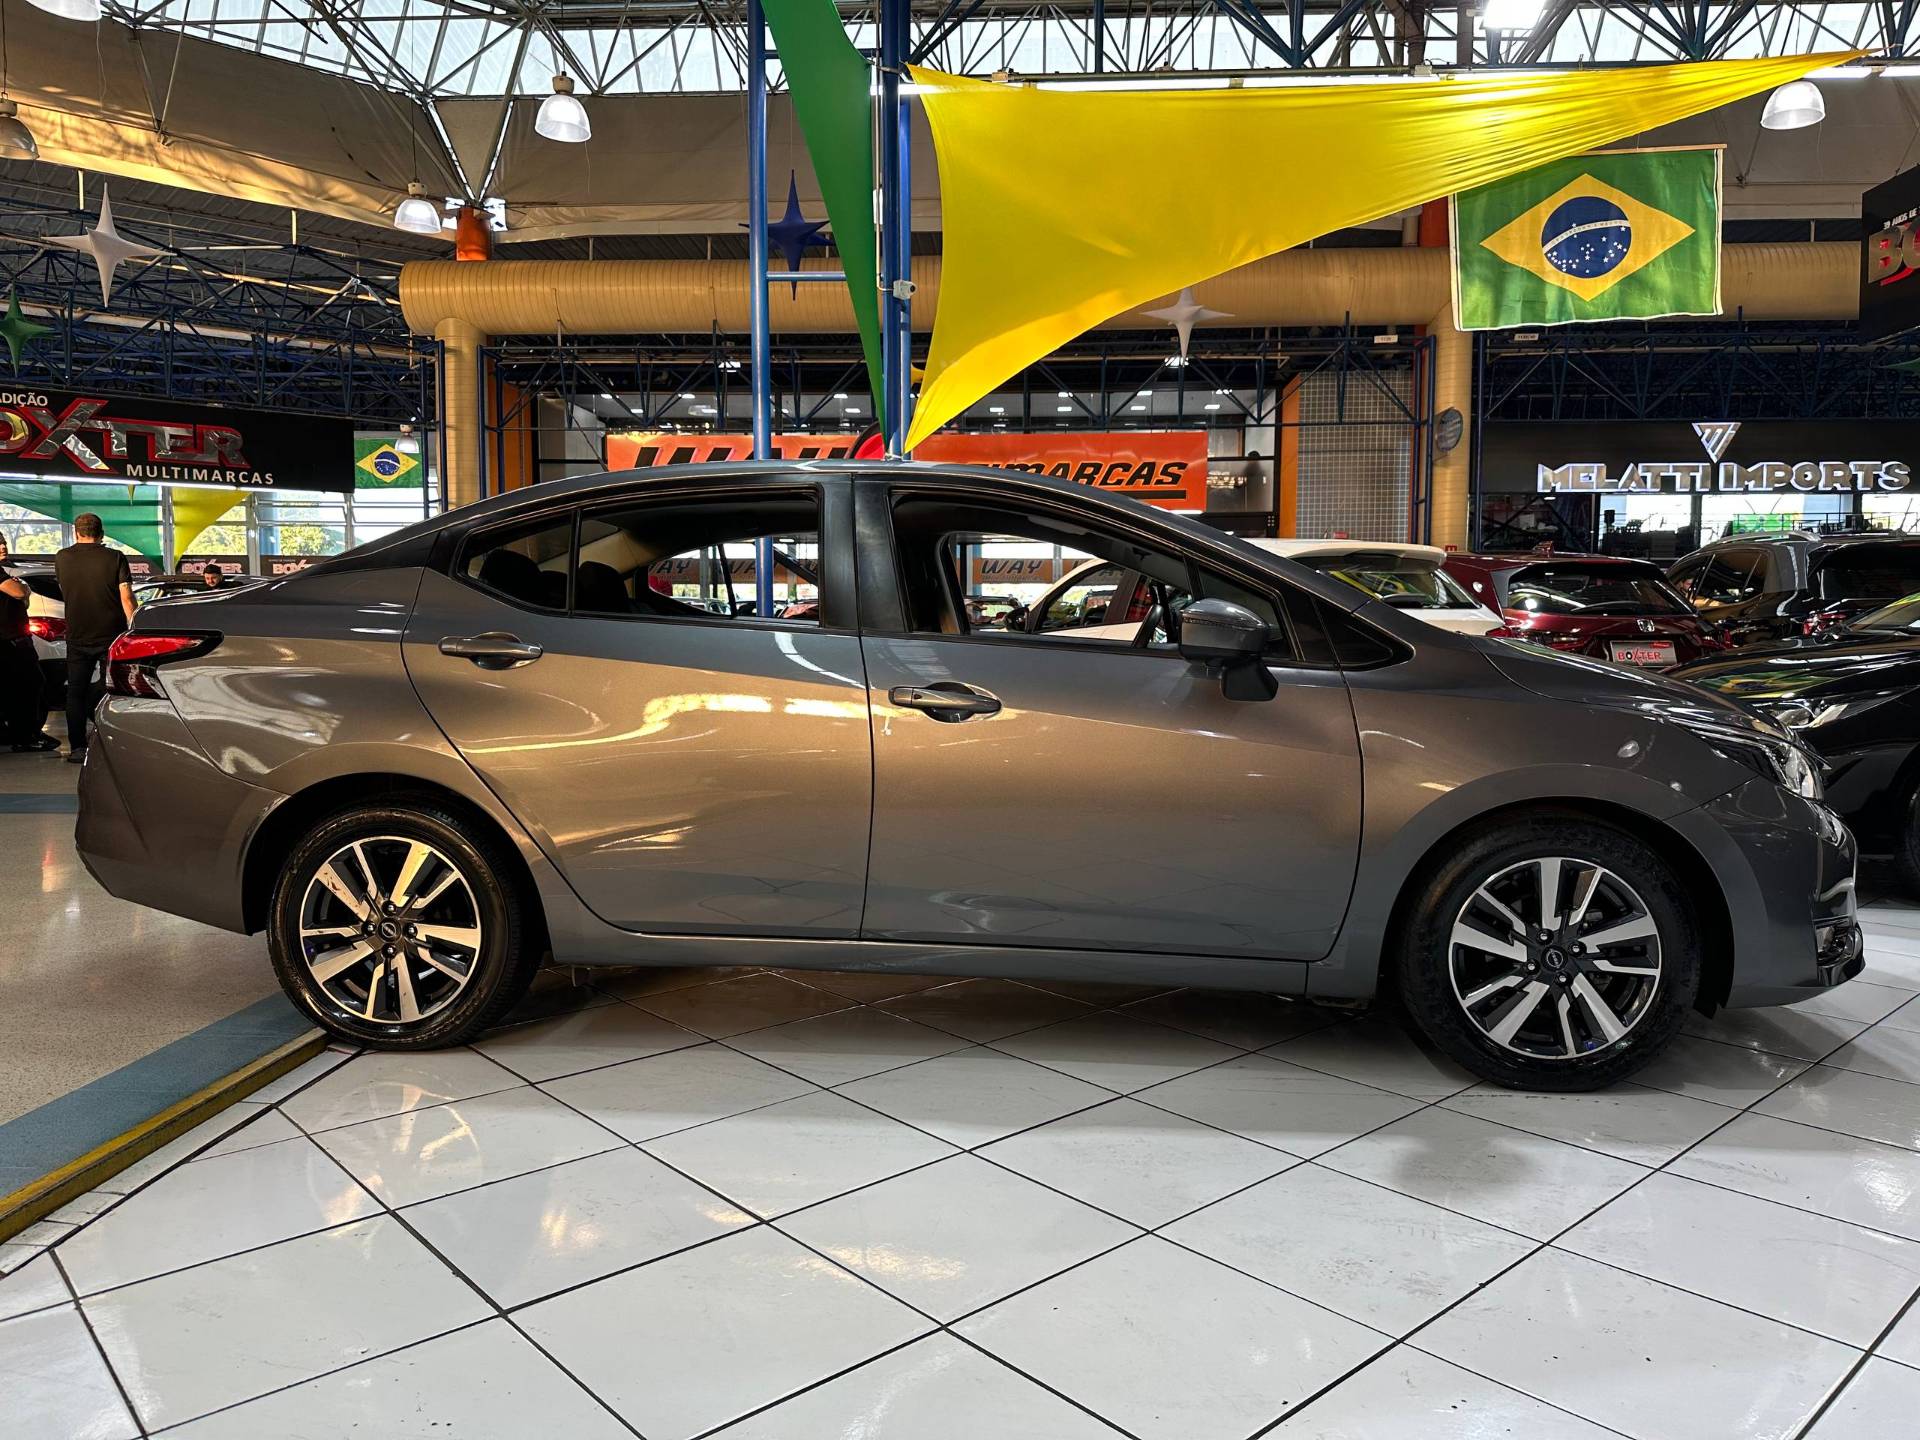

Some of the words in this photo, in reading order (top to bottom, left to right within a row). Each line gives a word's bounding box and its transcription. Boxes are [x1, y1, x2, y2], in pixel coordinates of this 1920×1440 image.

[126, 463, 274, 485] MULTIMARCAS
[1537, 463, 1711, 493] MELATTI
[1718, 460, 1911, 492] IMPORTS
[981, 560, 1043, 575] WAY
[1616, 647, 1662, 666] BOXTER
